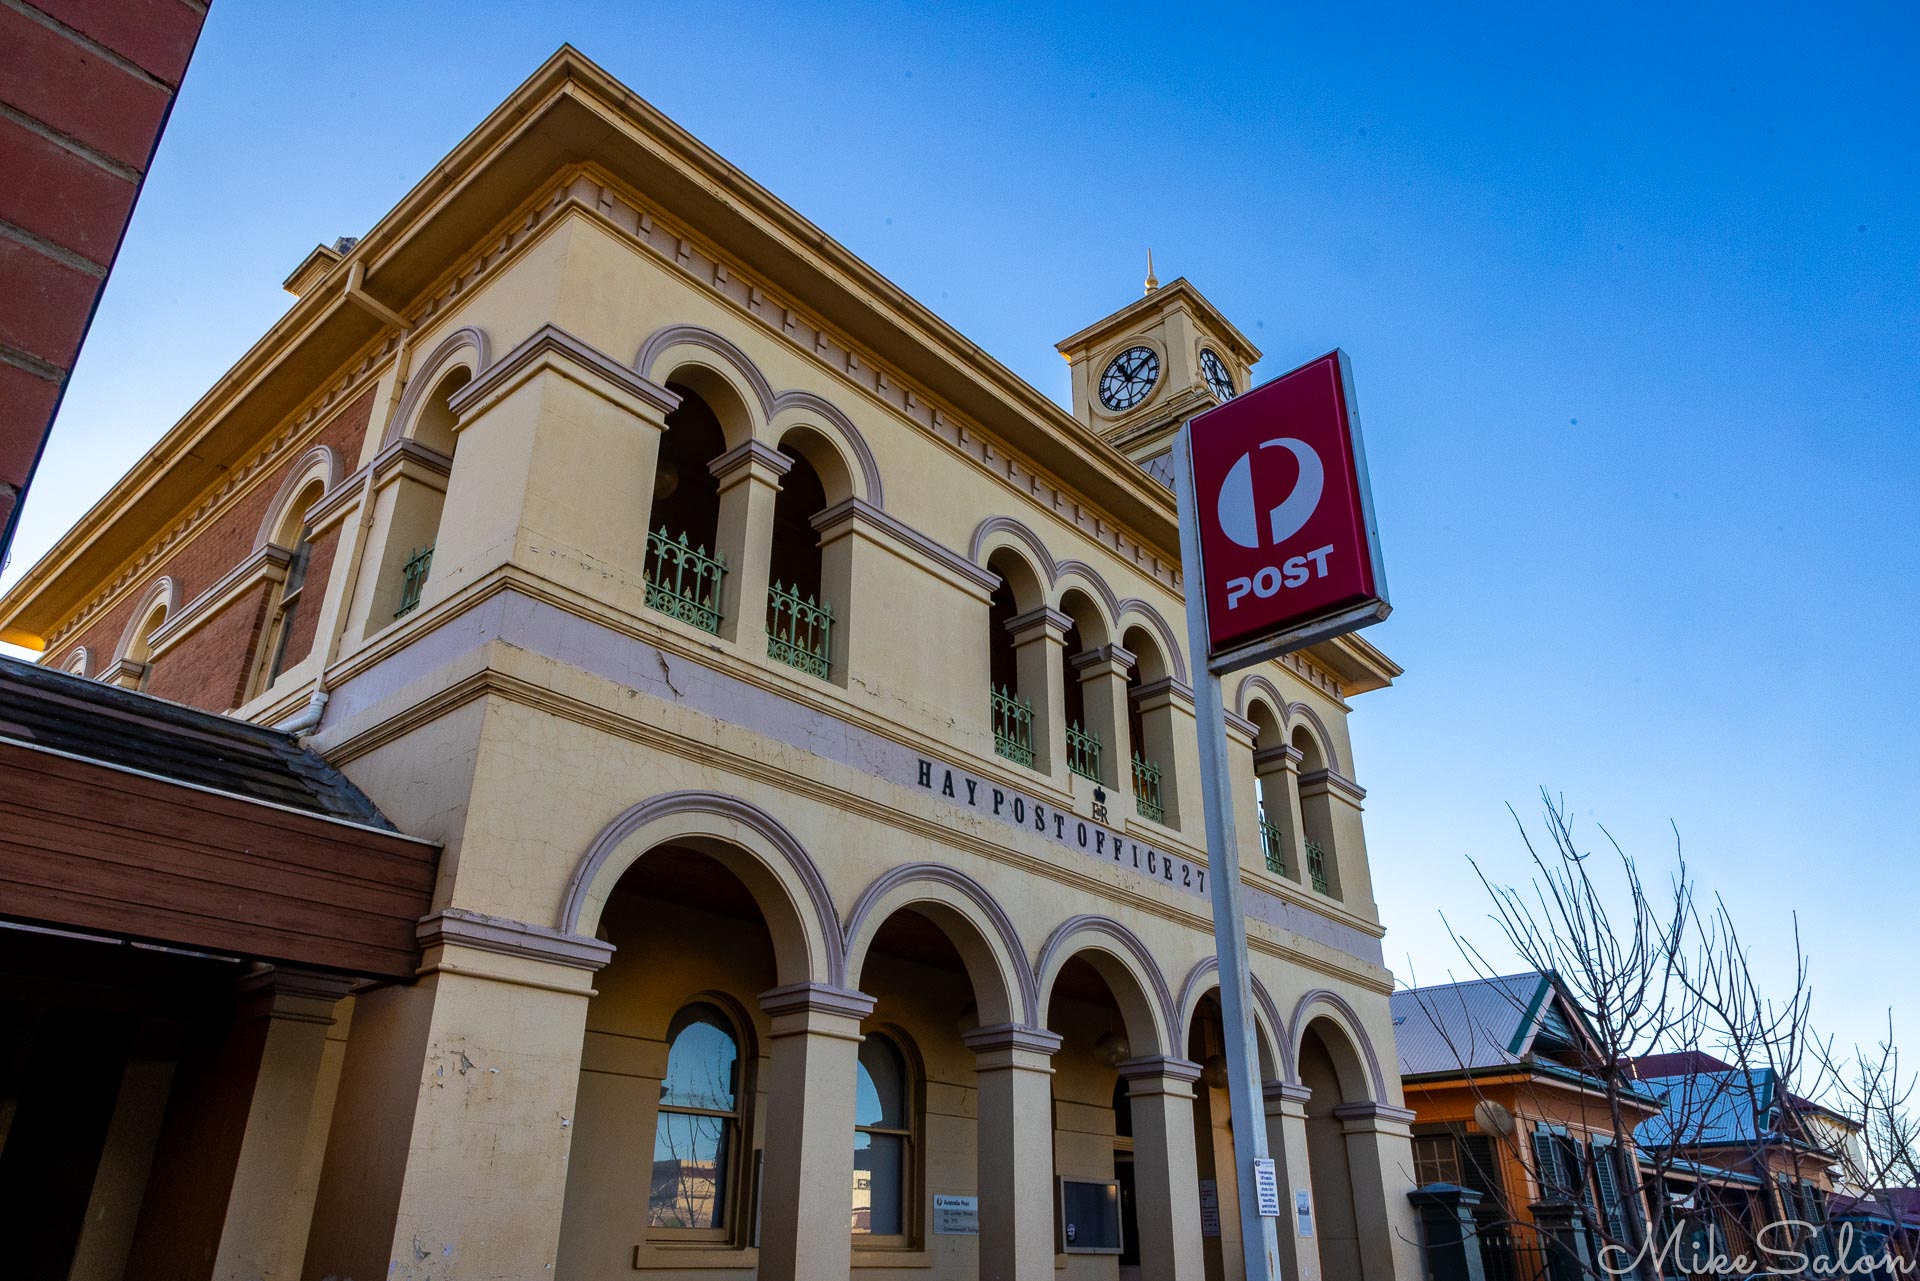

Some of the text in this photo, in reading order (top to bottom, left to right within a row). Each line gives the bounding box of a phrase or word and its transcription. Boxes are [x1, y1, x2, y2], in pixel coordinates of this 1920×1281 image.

[1226, 543, 1334, 610] POST
[917, 758, 977, 806] HAY
[992, 788, 1065, 840] POST
[1077, 822, 1173, 881] OFFICE
